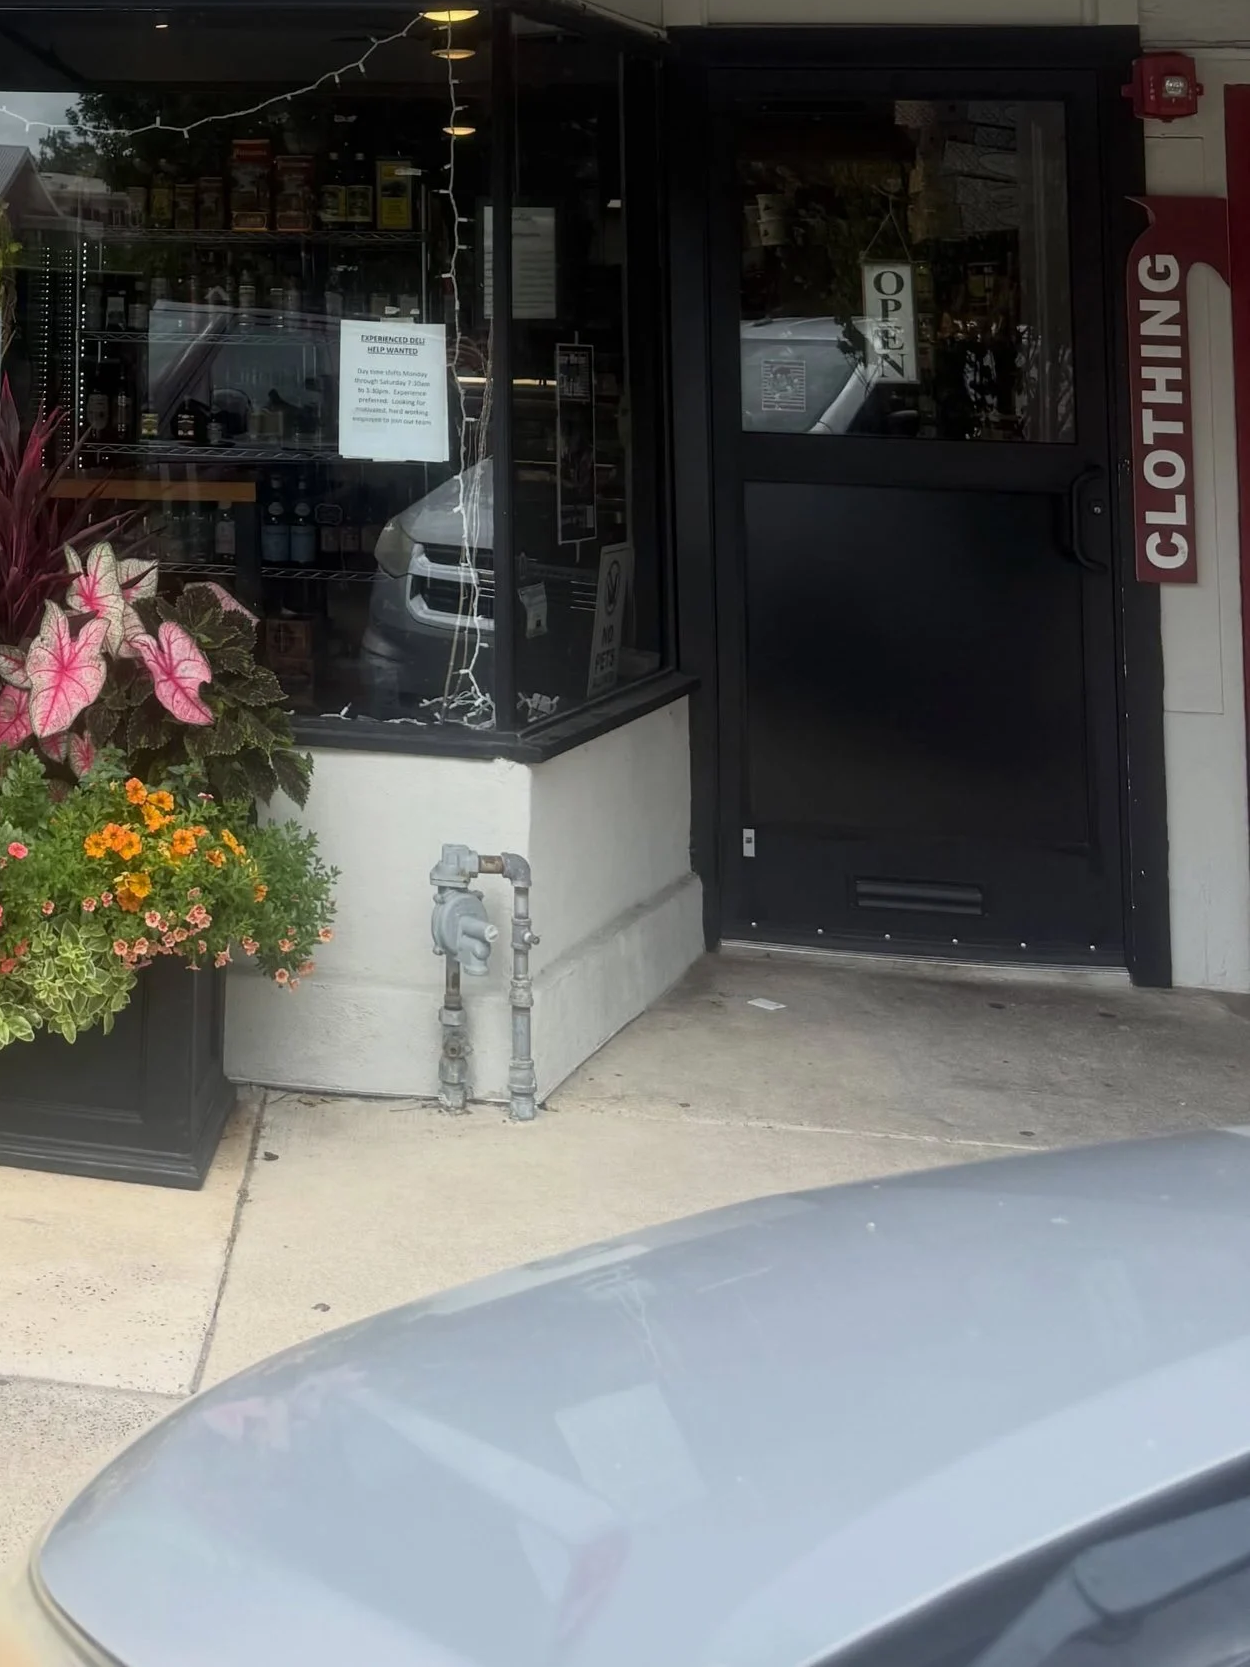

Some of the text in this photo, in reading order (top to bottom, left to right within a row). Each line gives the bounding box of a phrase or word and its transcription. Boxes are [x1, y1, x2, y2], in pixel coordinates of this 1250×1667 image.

[873, 270, 906, 379] OPEN
[361, 335, 425, 345] EXPERIENCED DELI
[367, 346, 418, 356] HELP WANTED
[403, 370, 428, 378] Monday
[1137, 253, 1189, 570] CLOTHING
